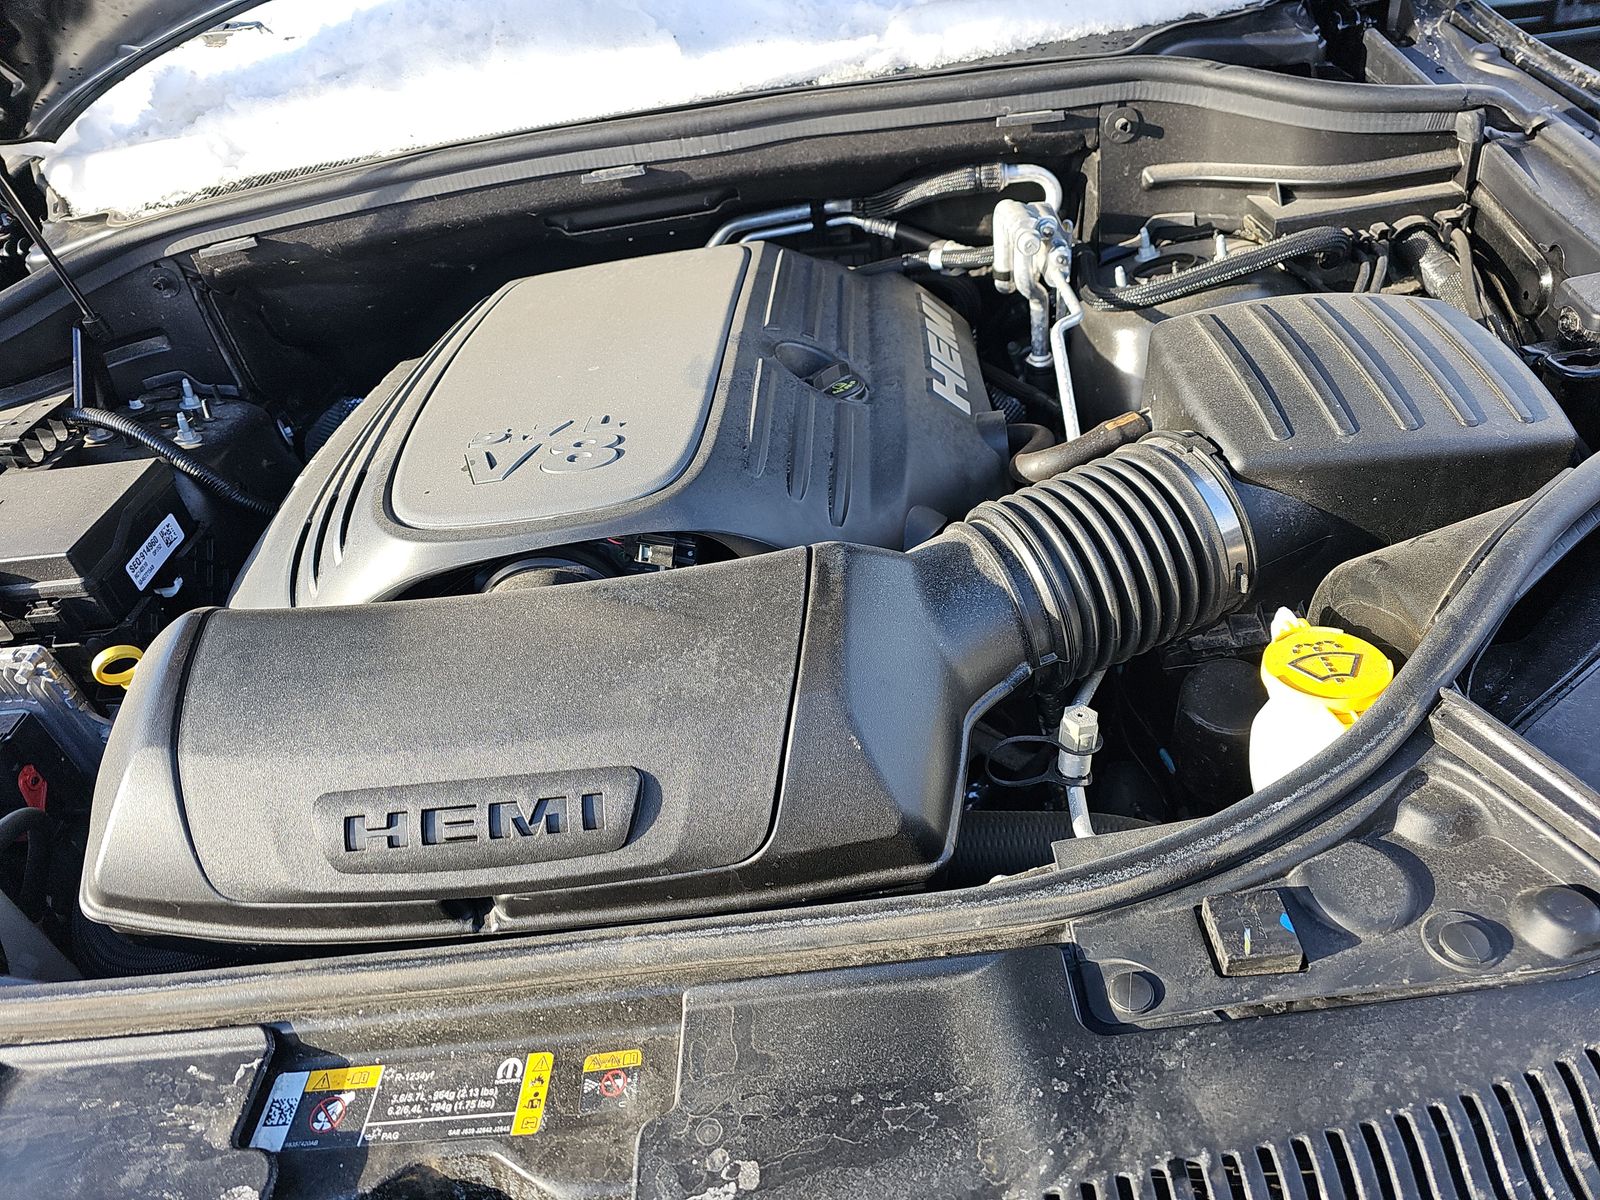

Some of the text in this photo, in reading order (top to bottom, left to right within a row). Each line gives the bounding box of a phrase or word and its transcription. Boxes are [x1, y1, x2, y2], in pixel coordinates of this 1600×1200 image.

[917, 292, 972, 416] HEMI
[463, 433, 626, 486] V8
[343, 792, 606, 852] HEMI
[395, 1070, 435, 1081] R-1234yf
[432, 1090, 455, 1102] 964g
[456, 1088, 480, 1099] (2.13
[481, 1086, 498, 1098] lbs)
[387, 1104, 423, 1116] 6.2/6.4L
[430, 1102, 452, 1113] 794g
[454, 1100, 476, 1112] (1.75
[477, 1098, 495, 1109] lbs)
[381, 1131, 400, 1140] PAG
